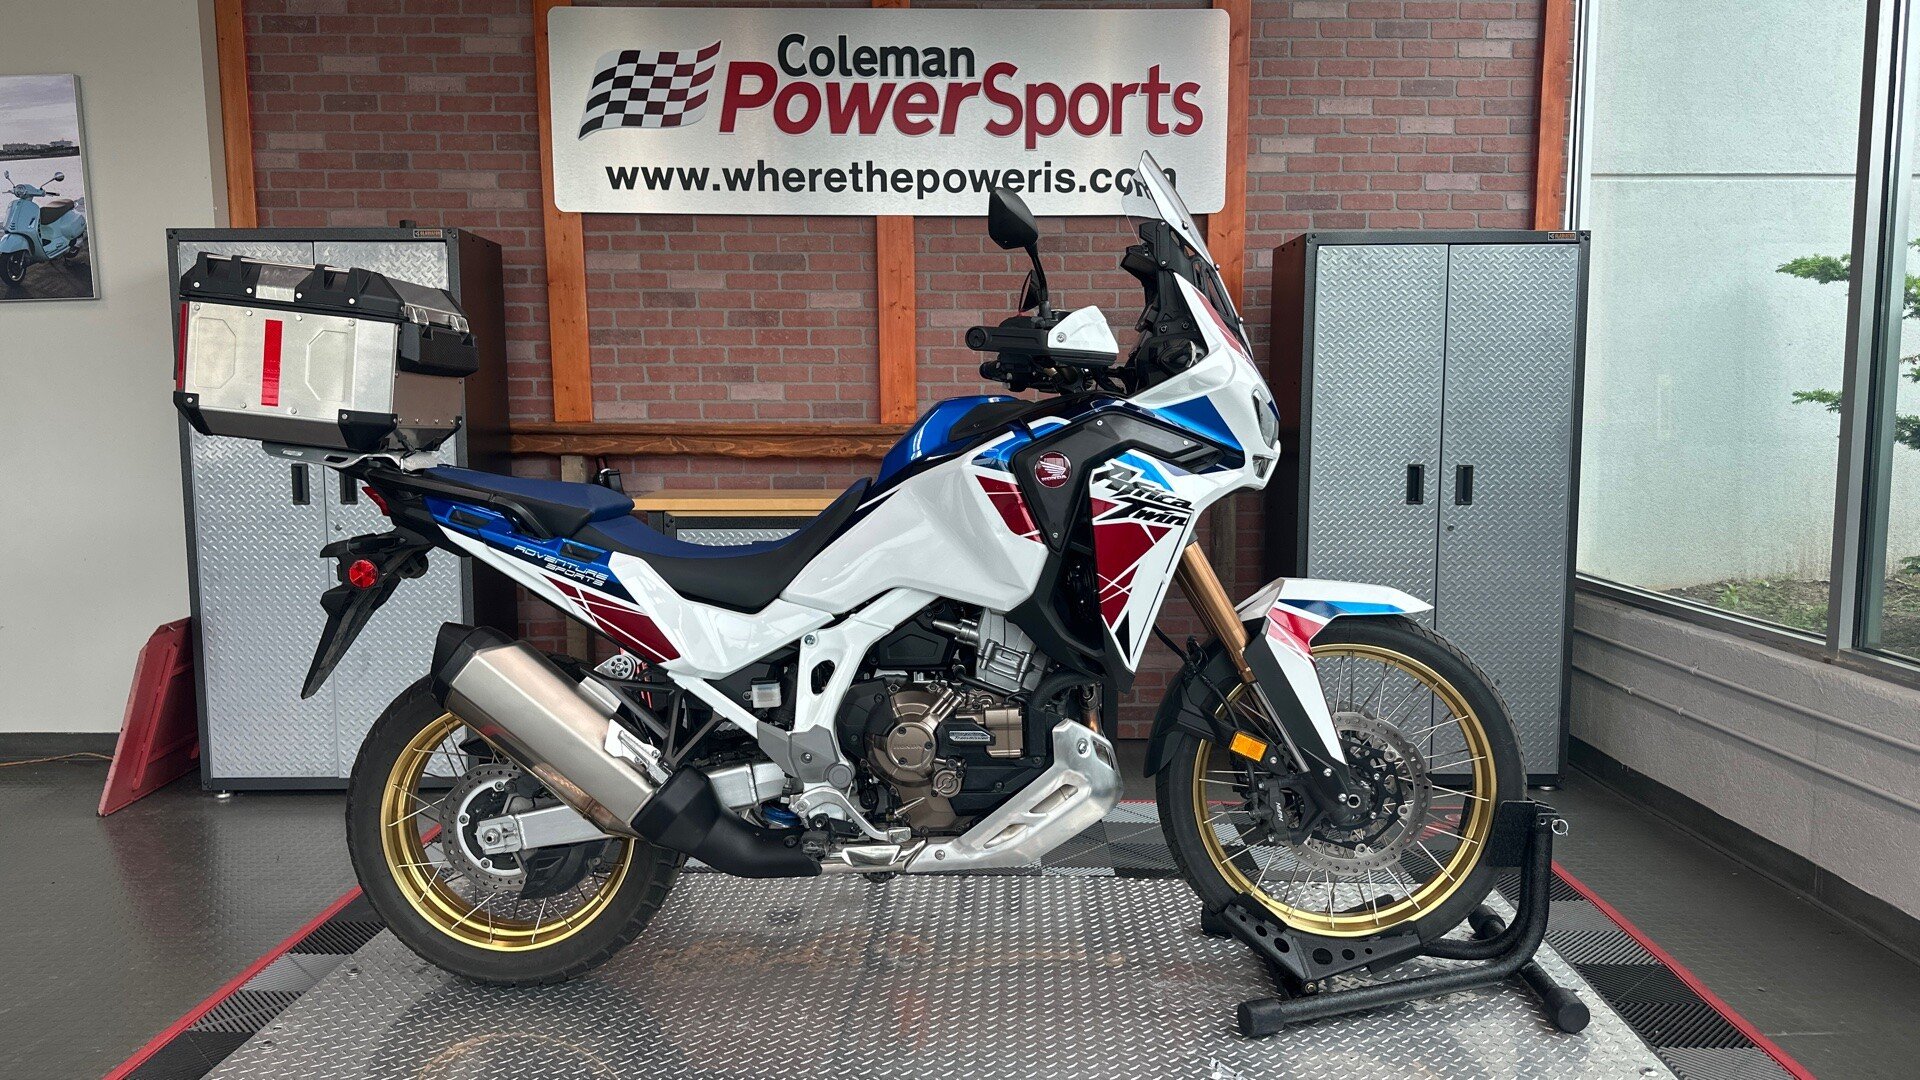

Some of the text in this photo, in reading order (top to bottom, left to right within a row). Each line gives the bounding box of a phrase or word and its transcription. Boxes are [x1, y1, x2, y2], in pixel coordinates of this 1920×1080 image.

[777, 33, 975, 77] Coleman
[718, 61, 1202, 150] PowerSports
[1093, 463, 1192, 509] Africa
[1097, 496, 1194, 526] Twin
[513, 544, 609, 581] ADVENTURE
[545, 563, 605, 587] SPORTS
